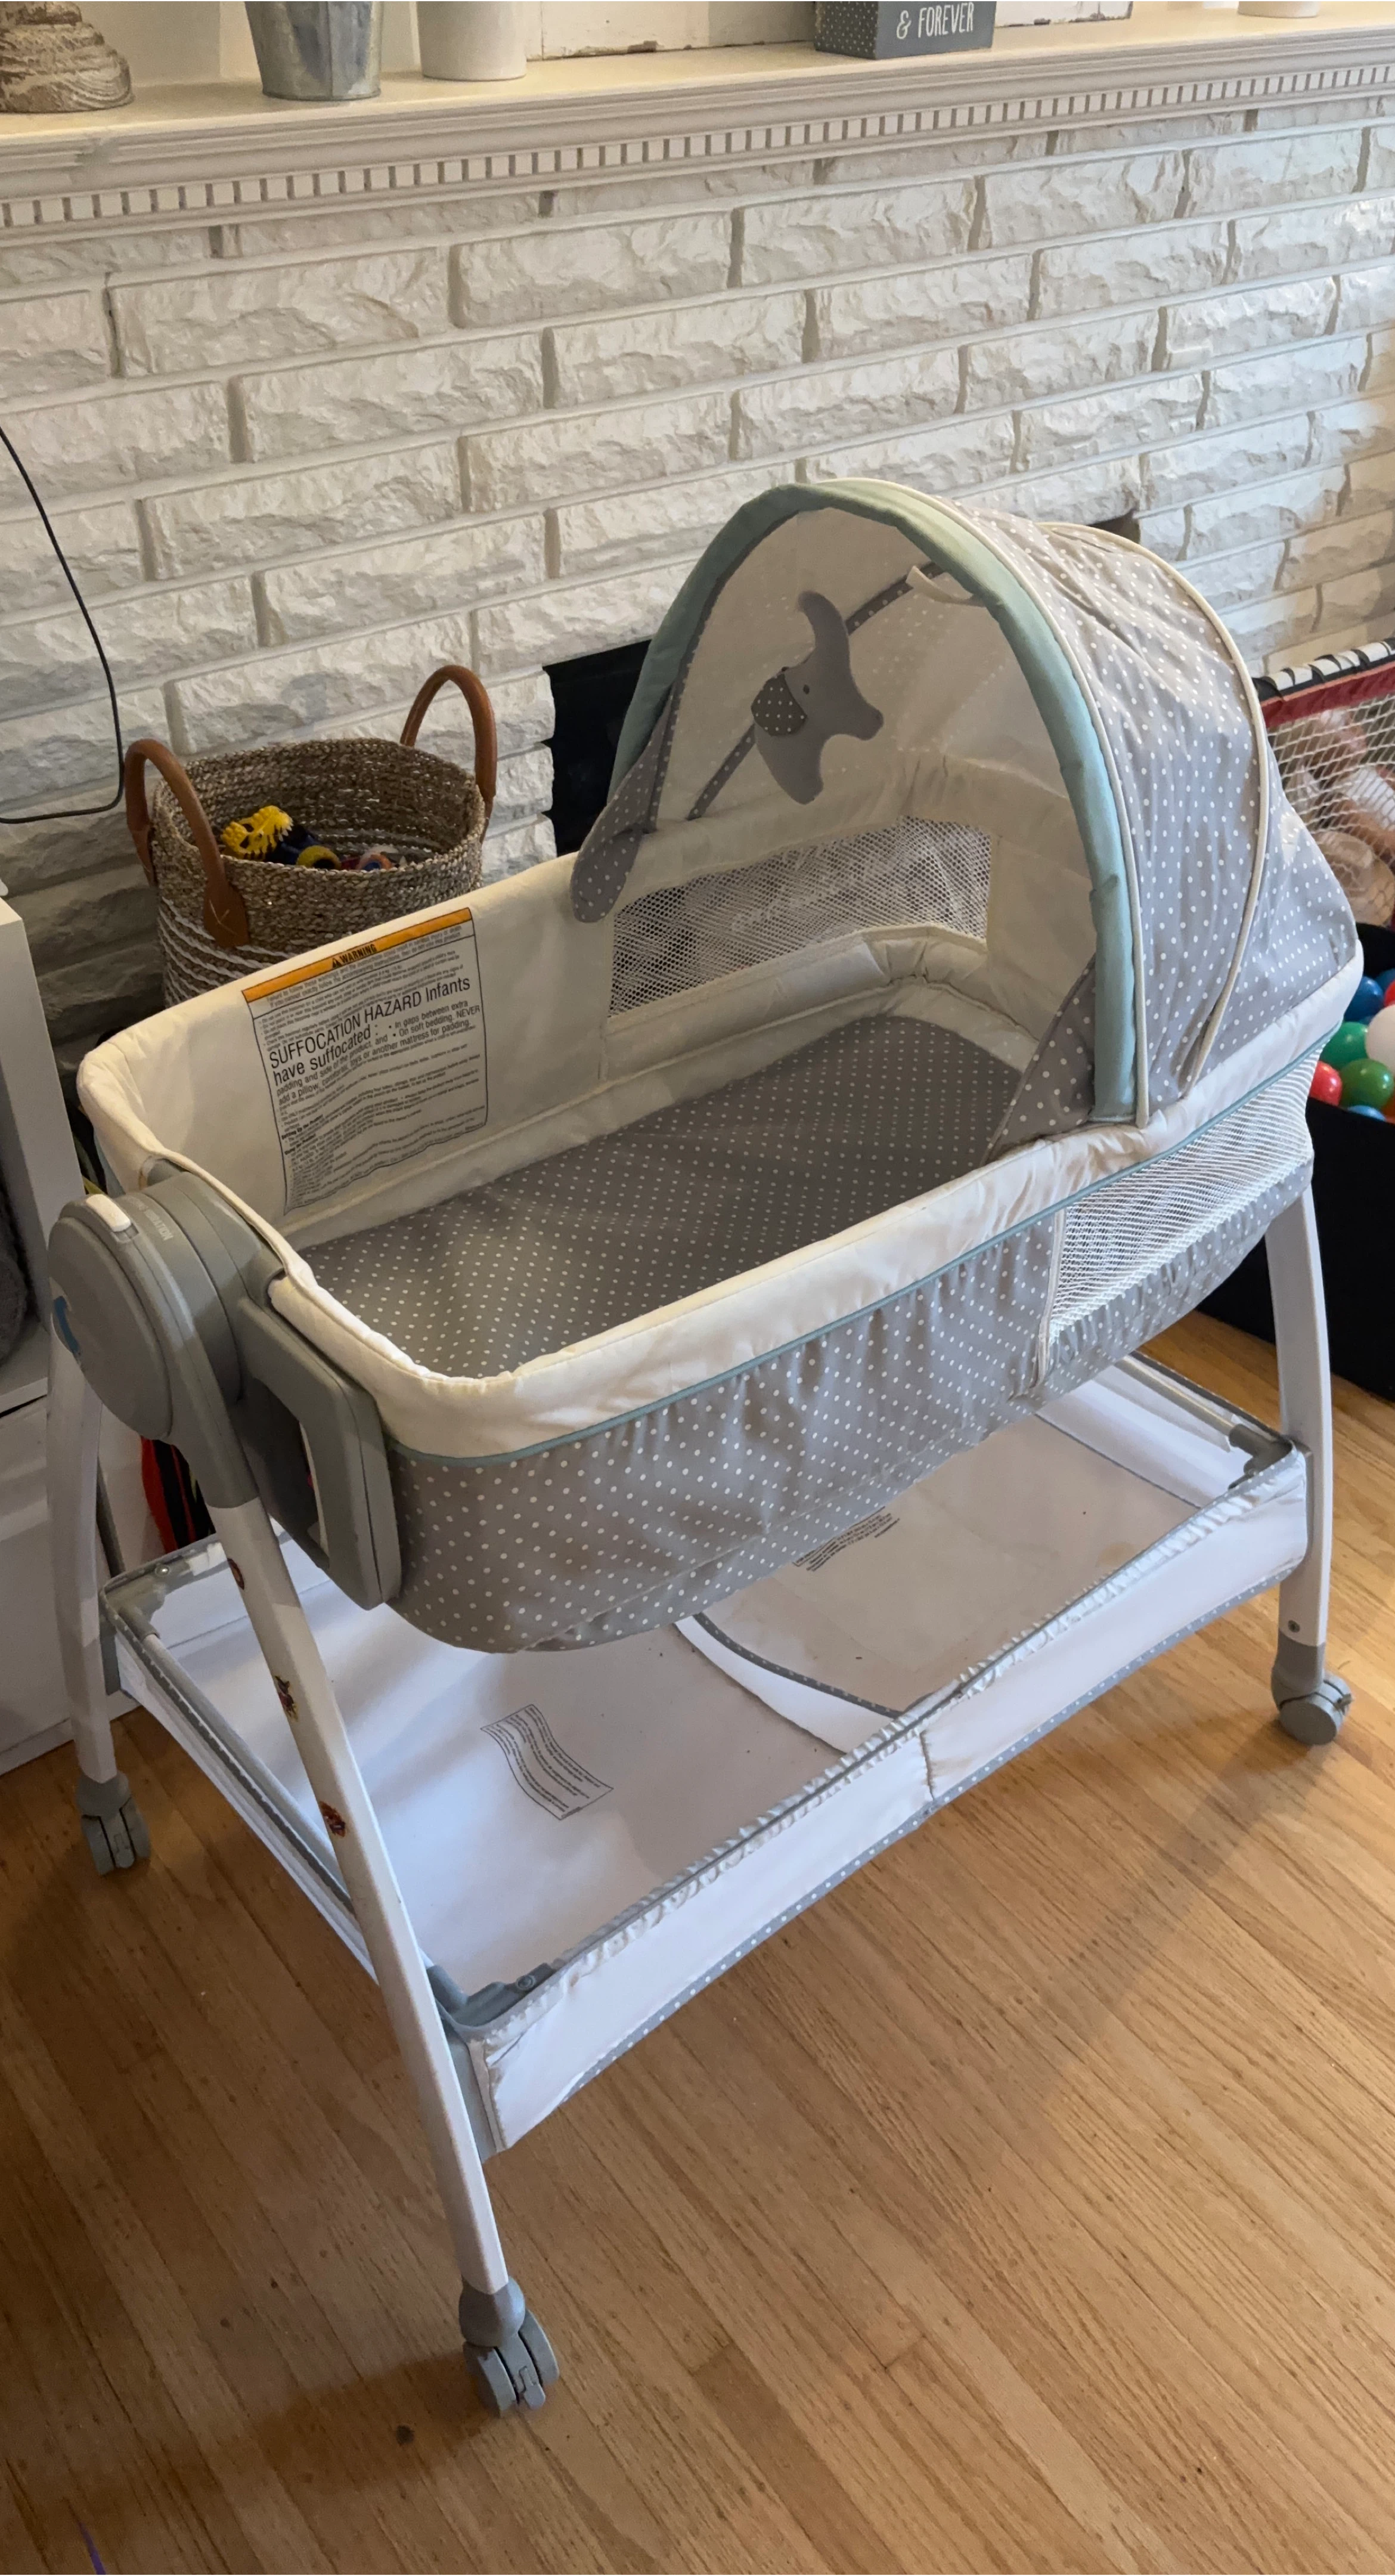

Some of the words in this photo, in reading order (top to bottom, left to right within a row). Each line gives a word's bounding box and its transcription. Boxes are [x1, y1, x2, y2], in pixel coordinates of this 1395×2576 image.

[896, 10, 912, 39] &
[918, 2, 974, 38] FOREVER
[339, 943, 377, 964] WARNING
[269, 1013, 361, 1069] SUFFOCATION
[364, 991, 421, 1023] HAZARD
[426, 977, 470, 1002] Infants
[399, 1028, 408, 1037] On
[410, 1021, 424, 1033] soft
[456, 1005, 480, 1018] NEVER
[403, 1015, 419, 1028] gaps
[421, 1005, 450, 1020] between
[451, 1000, 468, 1011] extra
[273, 1061, 305, 1086] have
[309, 1024, 371, 1071] suffocated
[277, 1079, 303, 1097] padding
[305, 1072, 318, 1083] and
[375, 1034, 388, 1045] and
[278, 1093, 290, 1106] add
[372, 1042, 398, 1055] another
[400, 1031, 429, 1046] mattress
[430, 1027, 439, 1036] for
